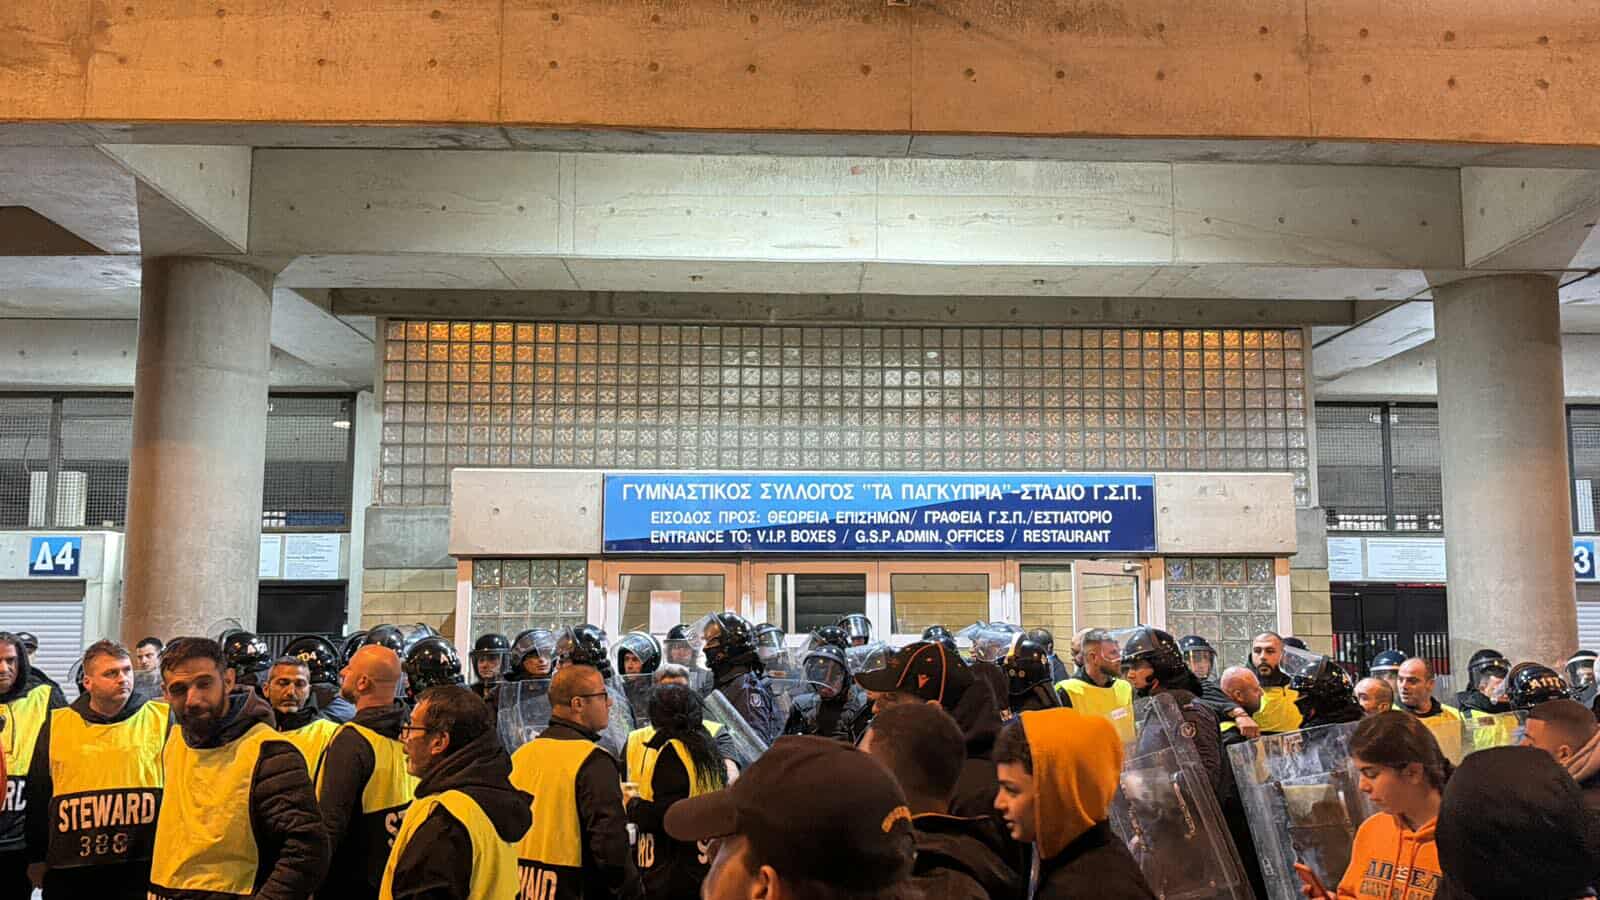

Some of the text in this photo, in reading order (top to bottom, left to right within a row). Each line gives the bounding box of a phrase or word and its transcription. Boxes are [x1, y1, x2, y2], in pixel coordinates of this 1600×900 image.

[622, 483, 752, 501] ΓΥΜΝΑΣΤΙΚΟΣ
[759, 483, 855, 501] ΣΥΛΛΟΓΟΣ
[1093, 484, 1142, 501] Γ.Σ.Π.
[650, 511, 712, 525] ΕΙΣΟΔΟΣ
[718, 511, 761, 524] ΠΡΟΣ:
[767, 511, 830, 525] ΘΕΩΡΕΙΑ
[924, 511, 983, 524] ΓΡΑΦΕΙΑ
[650, 530, 724, 544] ENTRANCE
[729, 530, 752, 544] TO:
[756, 530, 787, 543] V.I.P.
[790, 530, 837, 543] BOXES
[842, 528, 850, 543] /
[946, 530, 1005, 543] OFFICES
[1010, 528, 1018, 543] /
[1023, 530, 1111, 543] RESTAURANT
[34, 541, 75, 571] Δ4
[1574, 546, 1591, 574] 3
[58, 791, 155, 833] STEWARD
